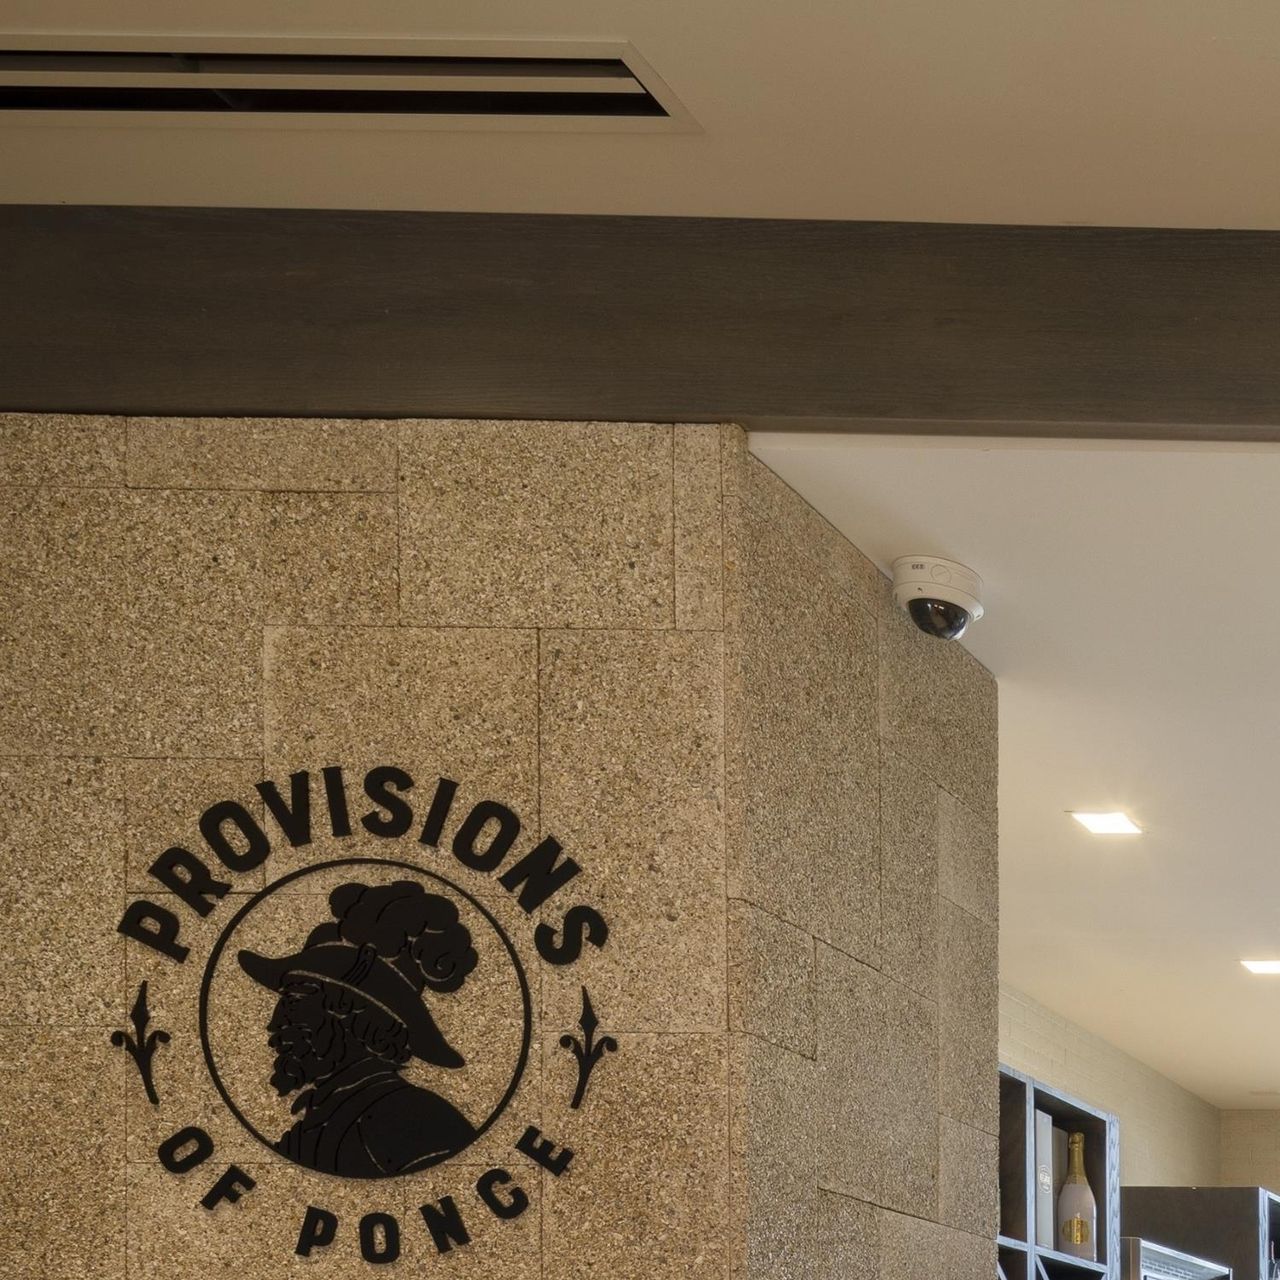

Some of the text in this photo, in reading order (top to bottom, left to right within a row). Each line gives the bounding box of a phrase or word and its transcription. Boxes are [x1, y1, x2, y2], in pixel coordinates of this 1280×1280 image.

[117, 766, 609, 966] PROVISIONS
[157, 1125, 575, 1264] OF PONCE
